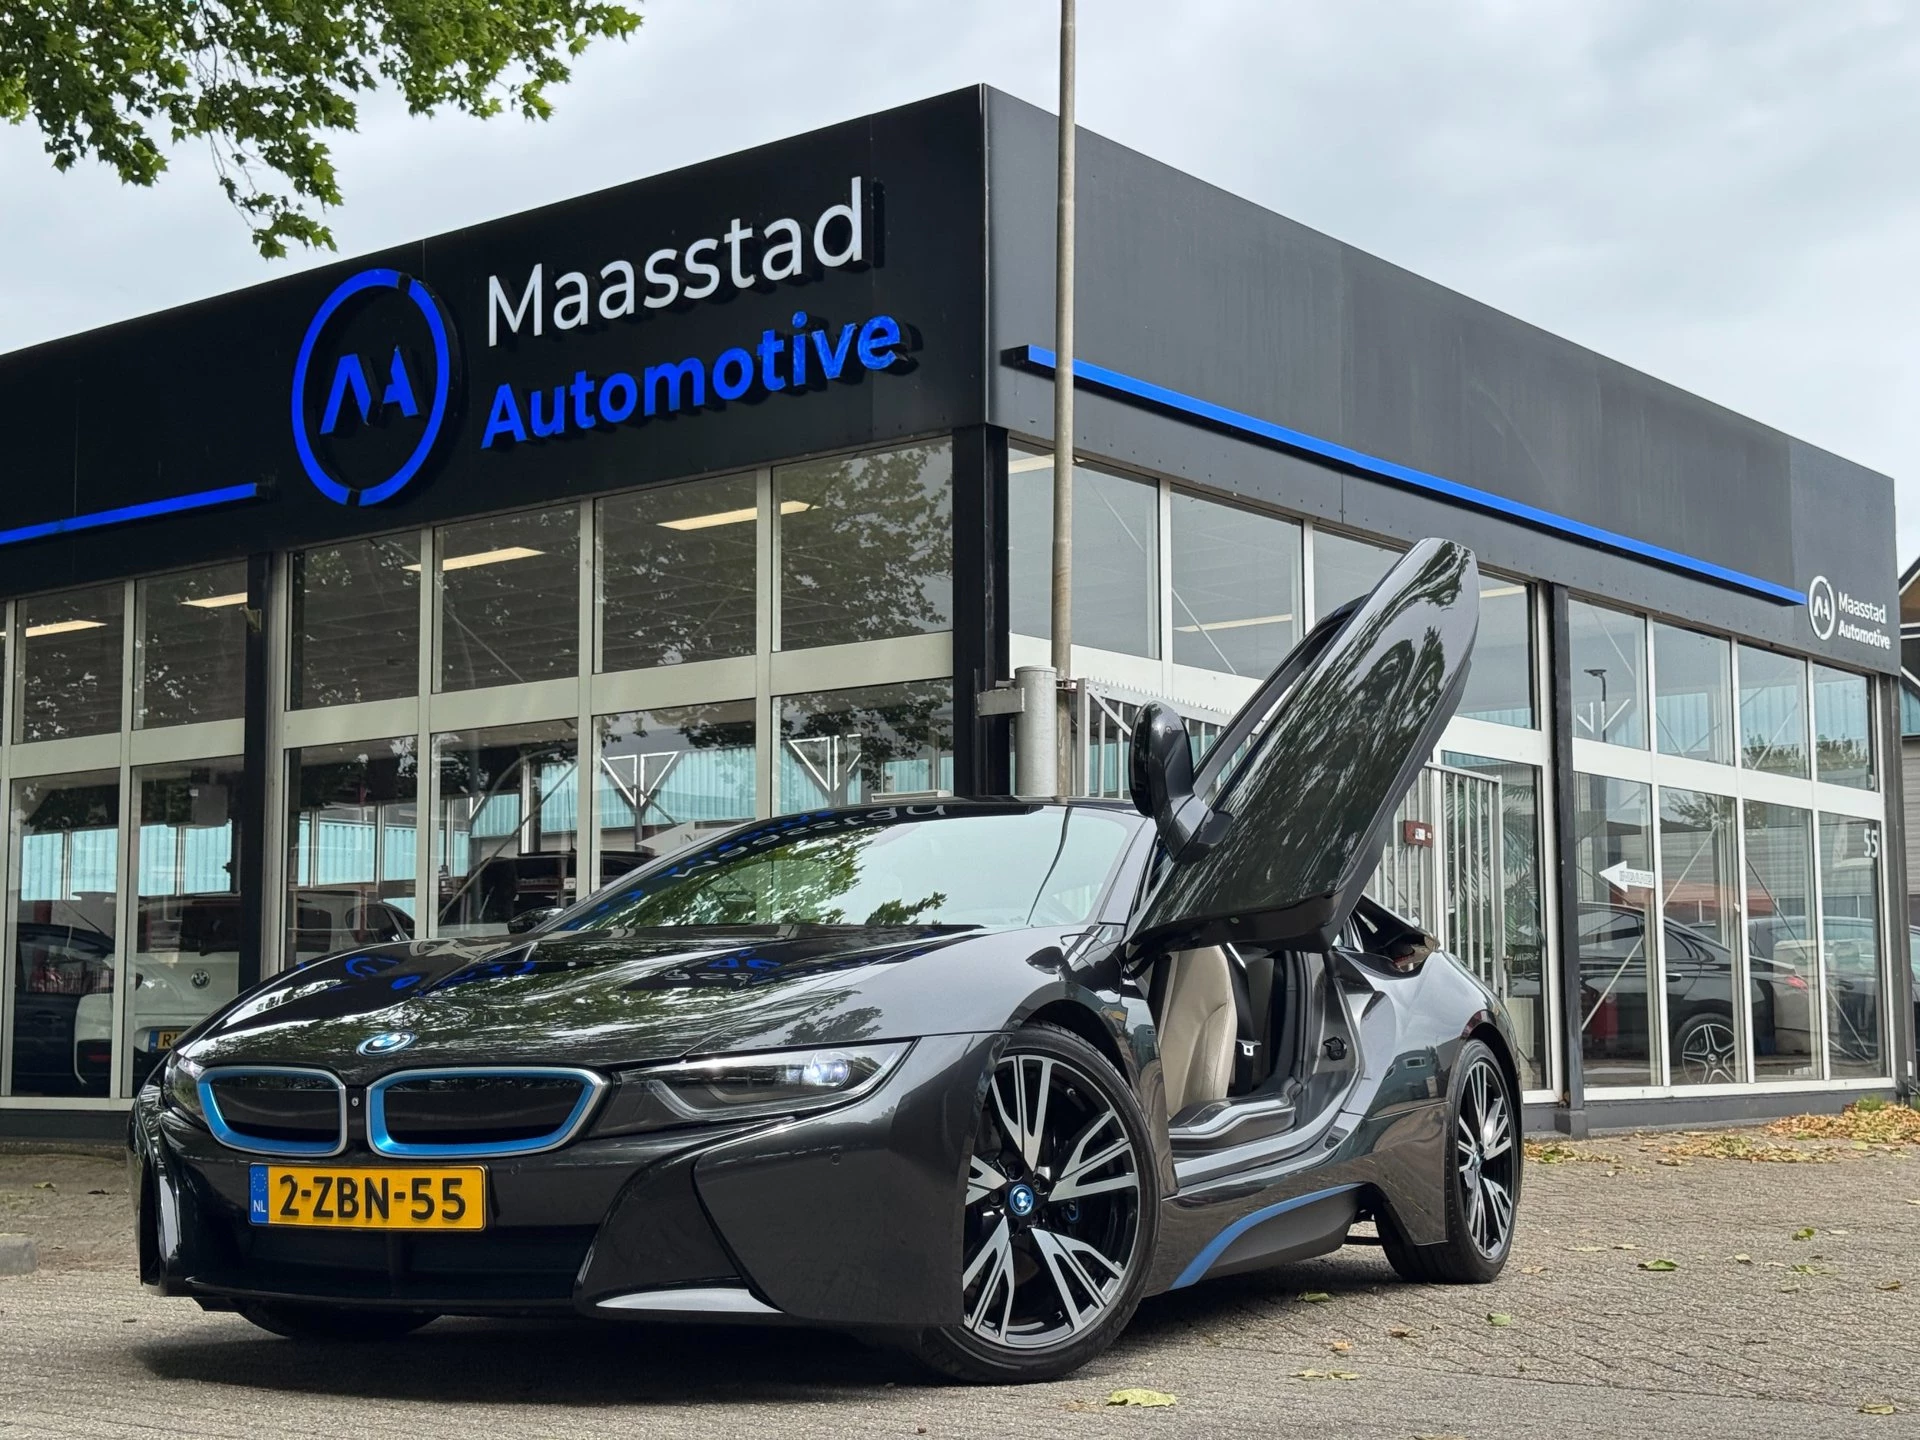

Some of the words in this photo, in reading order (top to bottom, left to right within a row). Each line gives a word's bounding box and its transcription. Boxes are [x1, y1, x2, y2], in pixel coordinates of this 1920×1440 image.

[487, 175, 863, 347] Maasstad
[480, 310, 902, 449] Automotive
[1838, 591, 1887, 624] Maasstad
[1837, 619, 1892, 650] Automotive
[1863, 828, 1878, 858] 55
[253, 1200, 267, 1213] NL
[279, 1174, 467, 1221] 2-ZBN-55
